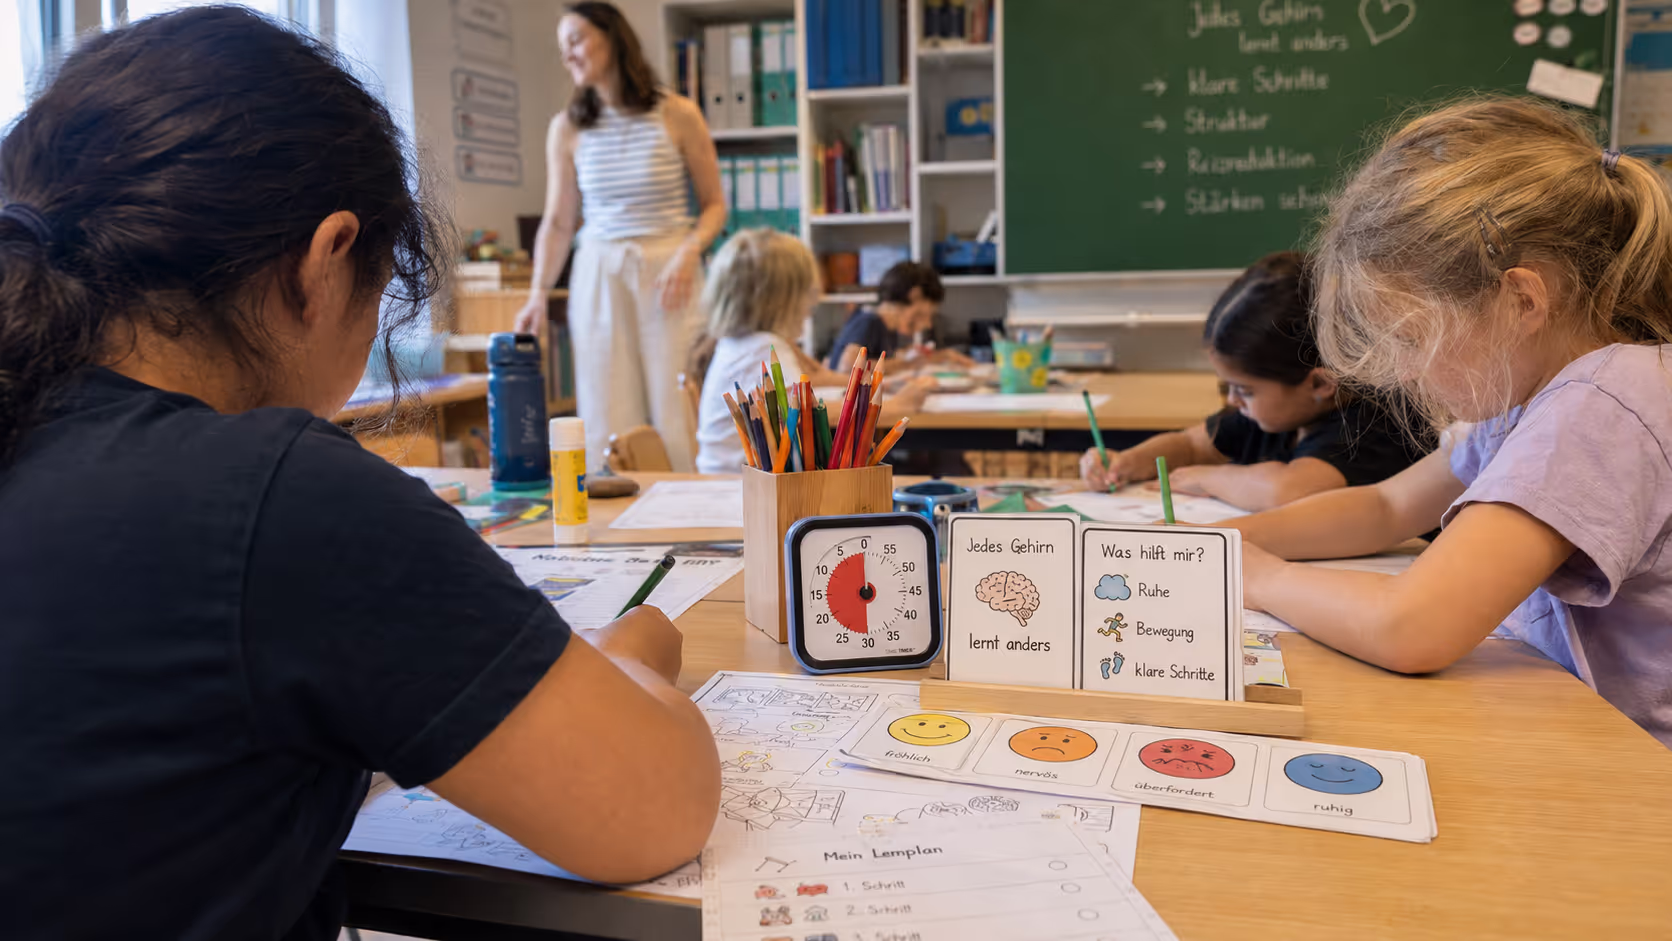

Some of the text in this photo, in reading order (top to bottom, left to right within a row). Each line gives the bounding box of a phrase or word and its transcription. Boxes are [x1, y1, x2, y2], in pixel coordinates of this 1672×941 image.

[1291, 27, 1349, 51] anders
[1187, 65, 1330, 95] klare Schritte
[1184, 106, 1272, 134] Struktur
[1184, 187, 1265, 215] Stärken
[861, 538, 868, 550] 0
[883, 543, 897, 555] 55
[966, 537, 1054, 555] Jedes Gehirn
[837, 545, 844, 557] 5
[1101, 543, 1205, 563] Was hilft mir?
[816, 565, 828, 576] 10
[902, 561, 916, 573] 50
[811, 589, 823, 601] 15
[908, 585, 922, 597] 45
[1138, 582, 1170, 599] Ruhe
[816, 612, 830, 625] 20
[904, 609, 917, 621] 40
[836, 632, 849, 644] 25
[887, 630, 900, 642] 35
[1136, 622, 1195, 643] Bewegung
[861, 637, 875, 649] 30
[968, 633, 1051, 652] lernt anders
[1134, 663, 1216, 682] klare Schritte
[884, 750, 932, 764] fröhlich
[1014, 767, 1059, 781] nervös
[1133, 781, 1216, 800] überfordert
[1313, 802, 1354, 816] ruhig
[823, 851, 863, 862] Mein
[861, 880, 906, 891] Schritt
